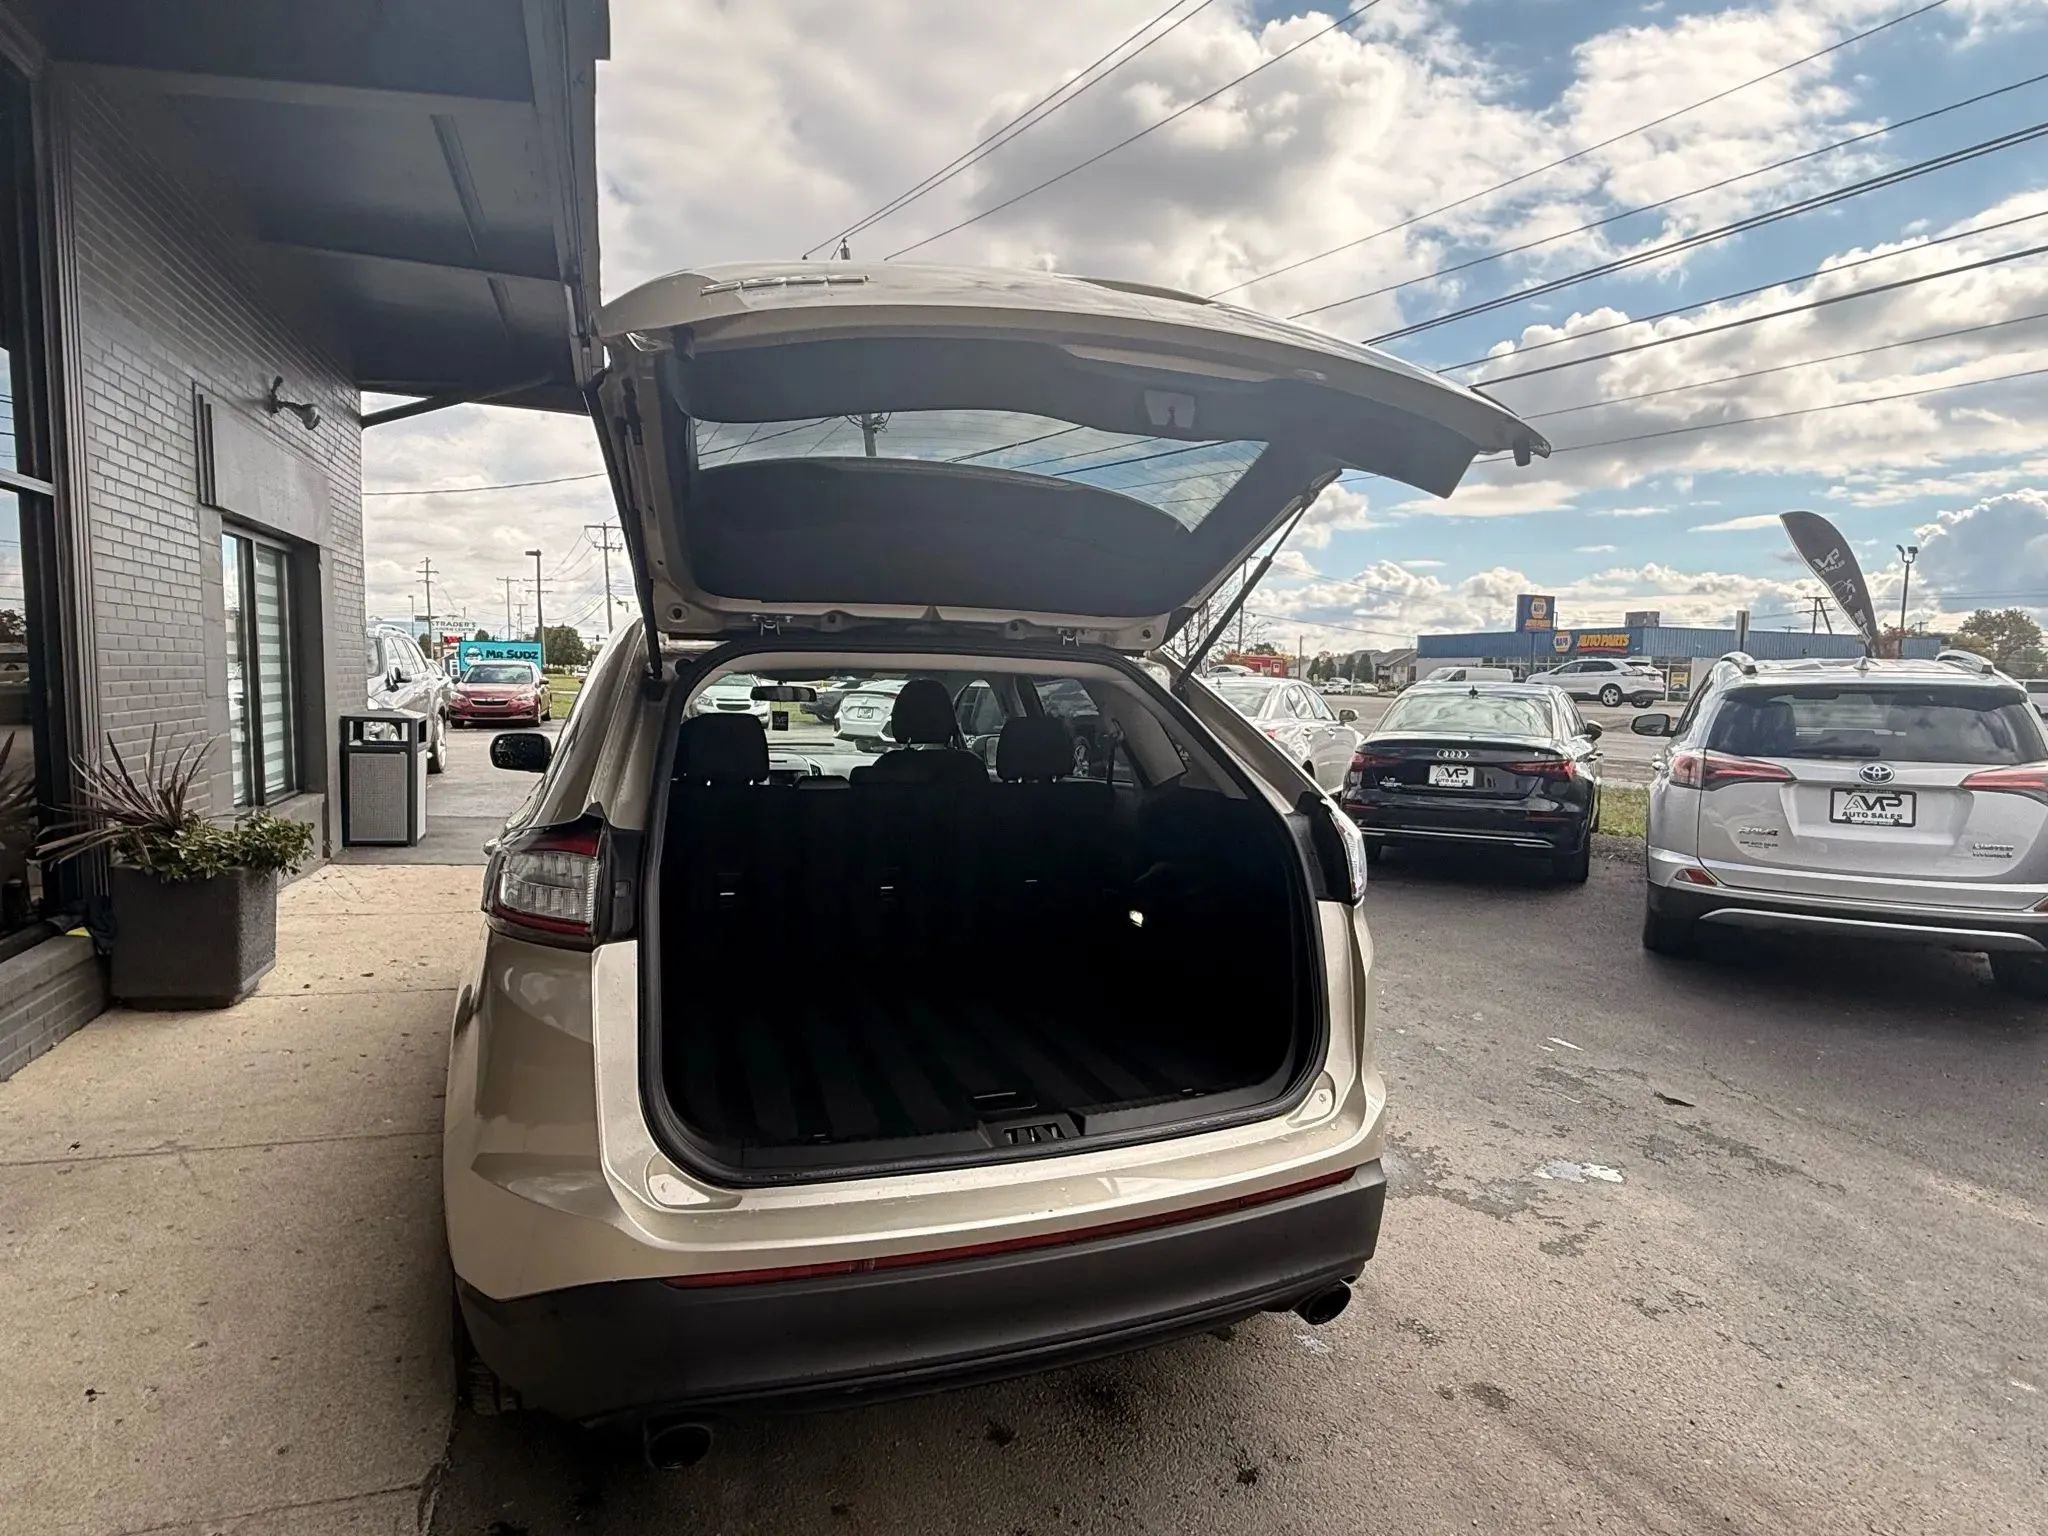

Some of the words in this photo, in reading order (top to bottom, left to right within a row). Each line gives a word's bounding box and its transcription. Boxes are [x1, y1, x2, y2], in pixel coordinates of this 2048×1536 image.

[1577, 634, 1601, 648] AUTO
[1600, 634, 1630, 648] PARTS
[1844, 794, 1903, 812] AVP
[1841, 811, 1869, 819] AUTO
[1871, 812, 1903, 820] SALES
